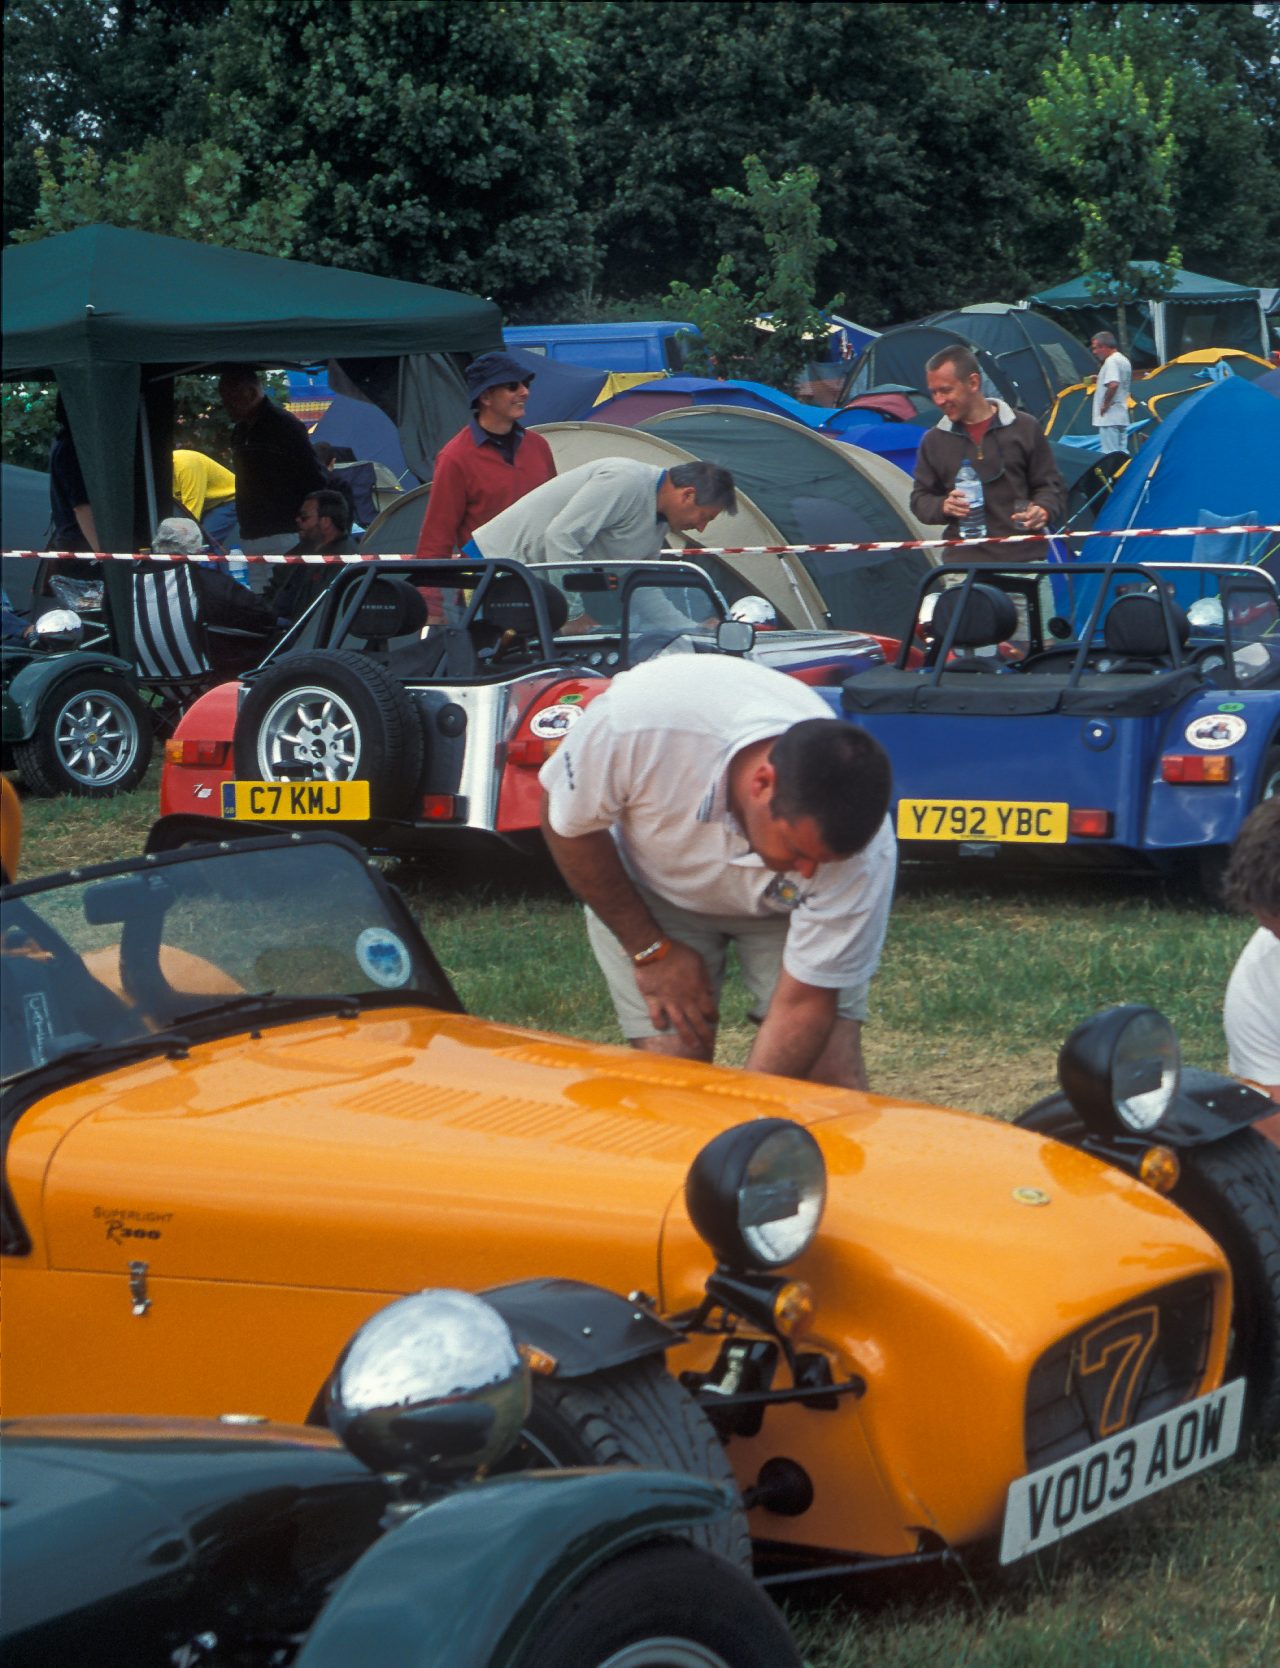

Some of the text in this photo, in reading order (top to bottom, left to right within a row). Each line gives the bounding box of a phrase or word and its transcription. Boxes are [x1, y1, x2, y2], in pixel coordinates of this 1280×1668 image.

[250, 786, 341, 815] C7 KMJ
[912, 805, 1053, 837] Y792 YBC
[1079, 1305, 1160, 1438] 7
[1144, 1395, 1228, 1487] AOW
